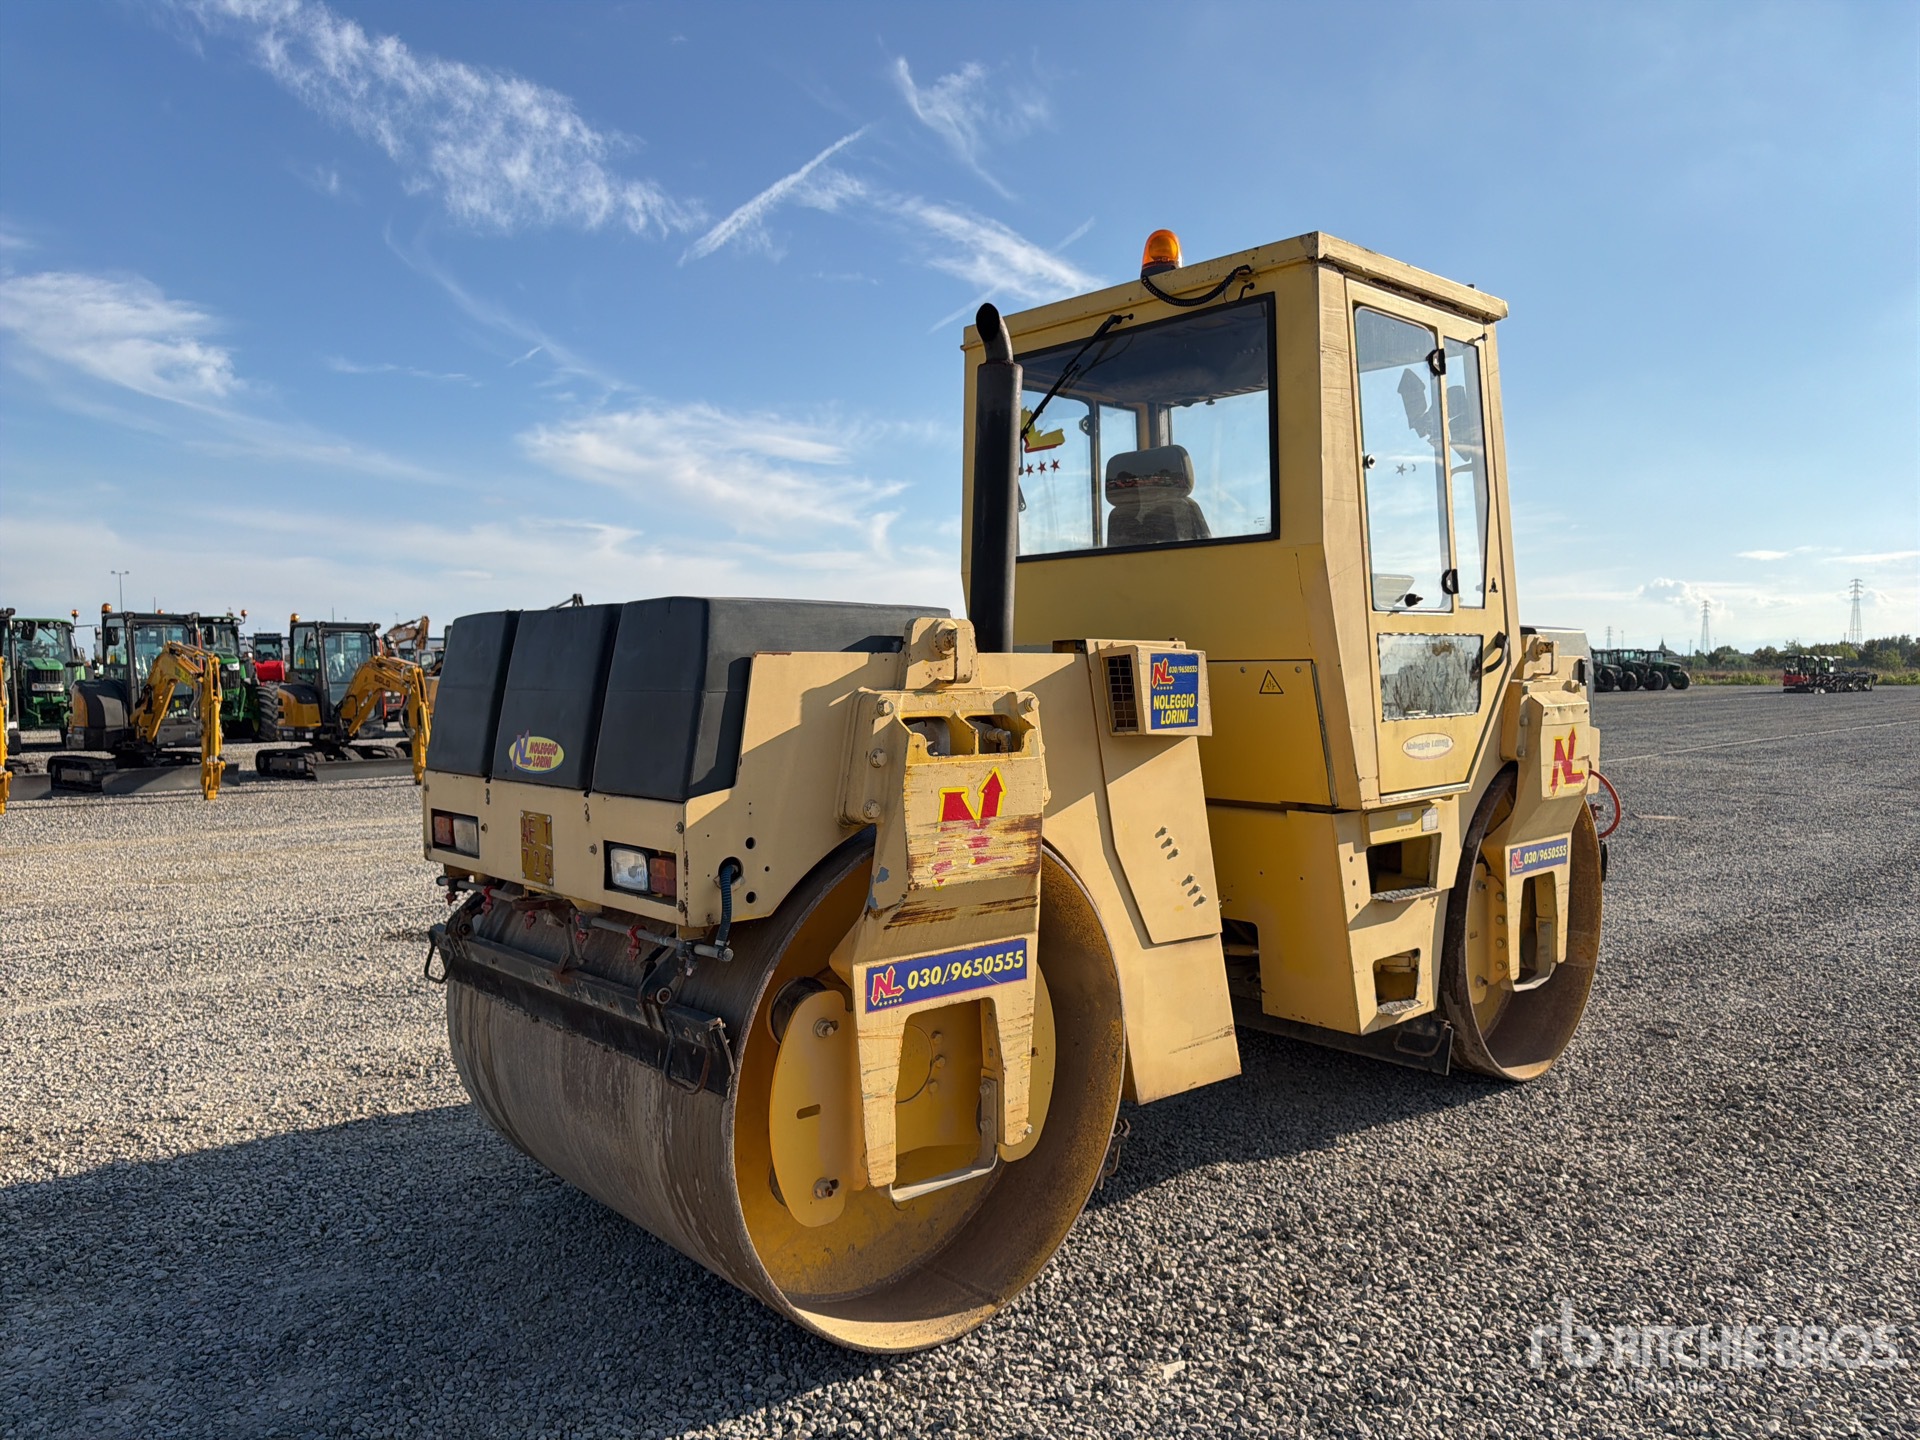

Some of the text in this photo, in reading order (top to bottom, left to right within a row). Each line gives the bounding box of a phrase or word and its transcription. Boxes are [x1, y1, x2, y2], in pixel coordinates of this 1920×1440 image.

[1153, 693, 1195, 710] NOLEGGIO
[1160, 709, 1189, 725] LORINI
[529, 741, 559, 756] NOLEGGIO
[532, 755, 553, 769] LORINI
[1523, 844, 1567, 865] 030/9650555
[907, 949, 1024, 991] 030/9650555
